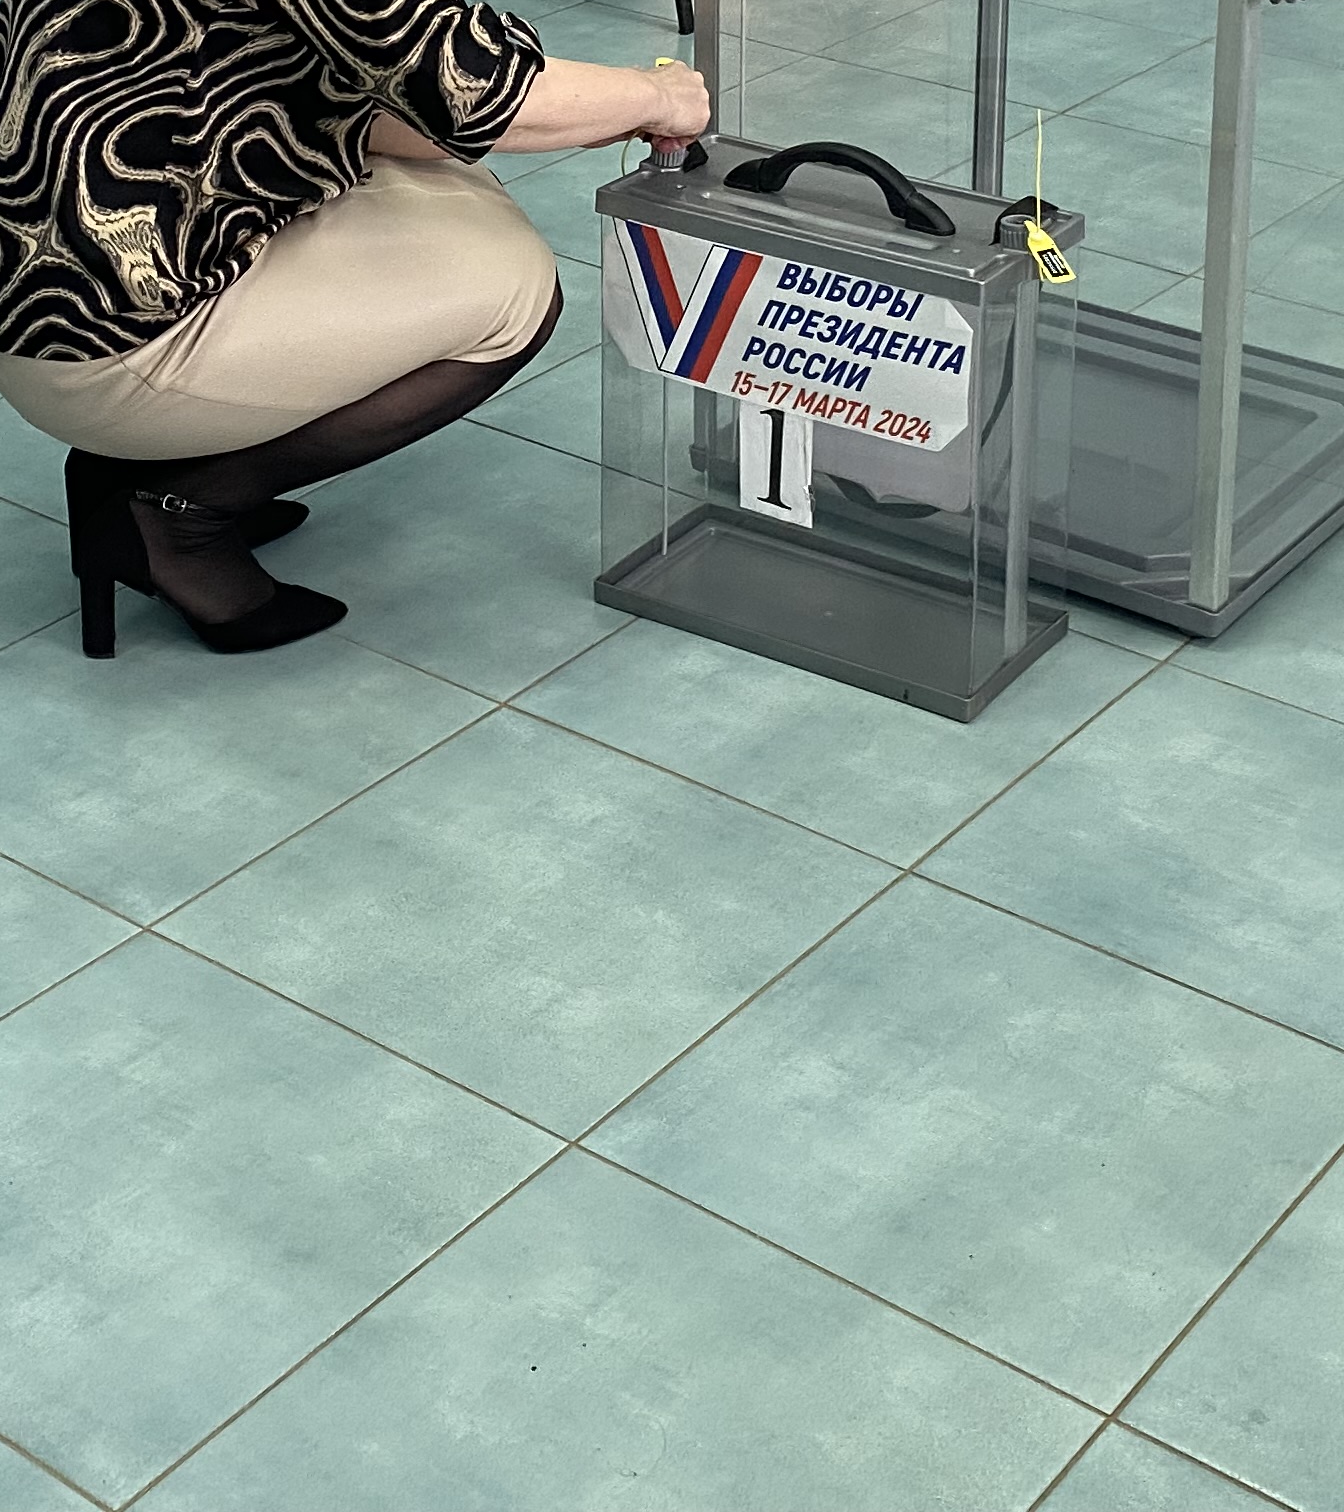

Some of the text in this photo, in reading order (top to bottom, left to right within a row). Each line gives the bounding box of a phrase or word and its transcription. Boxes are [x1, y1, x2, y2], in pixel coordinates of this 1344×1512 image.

[776, 262, 924, 322] ВЫБОРЫ
[741, 336, 872, 393] РОССИИ
[756, 299, 968, 375] ПРЕЗИДЕНТА
[792, 388, 871, 429] МАРТА
[873, 409, 933, 444] 2024
[756, 408, 792, 511] 1
